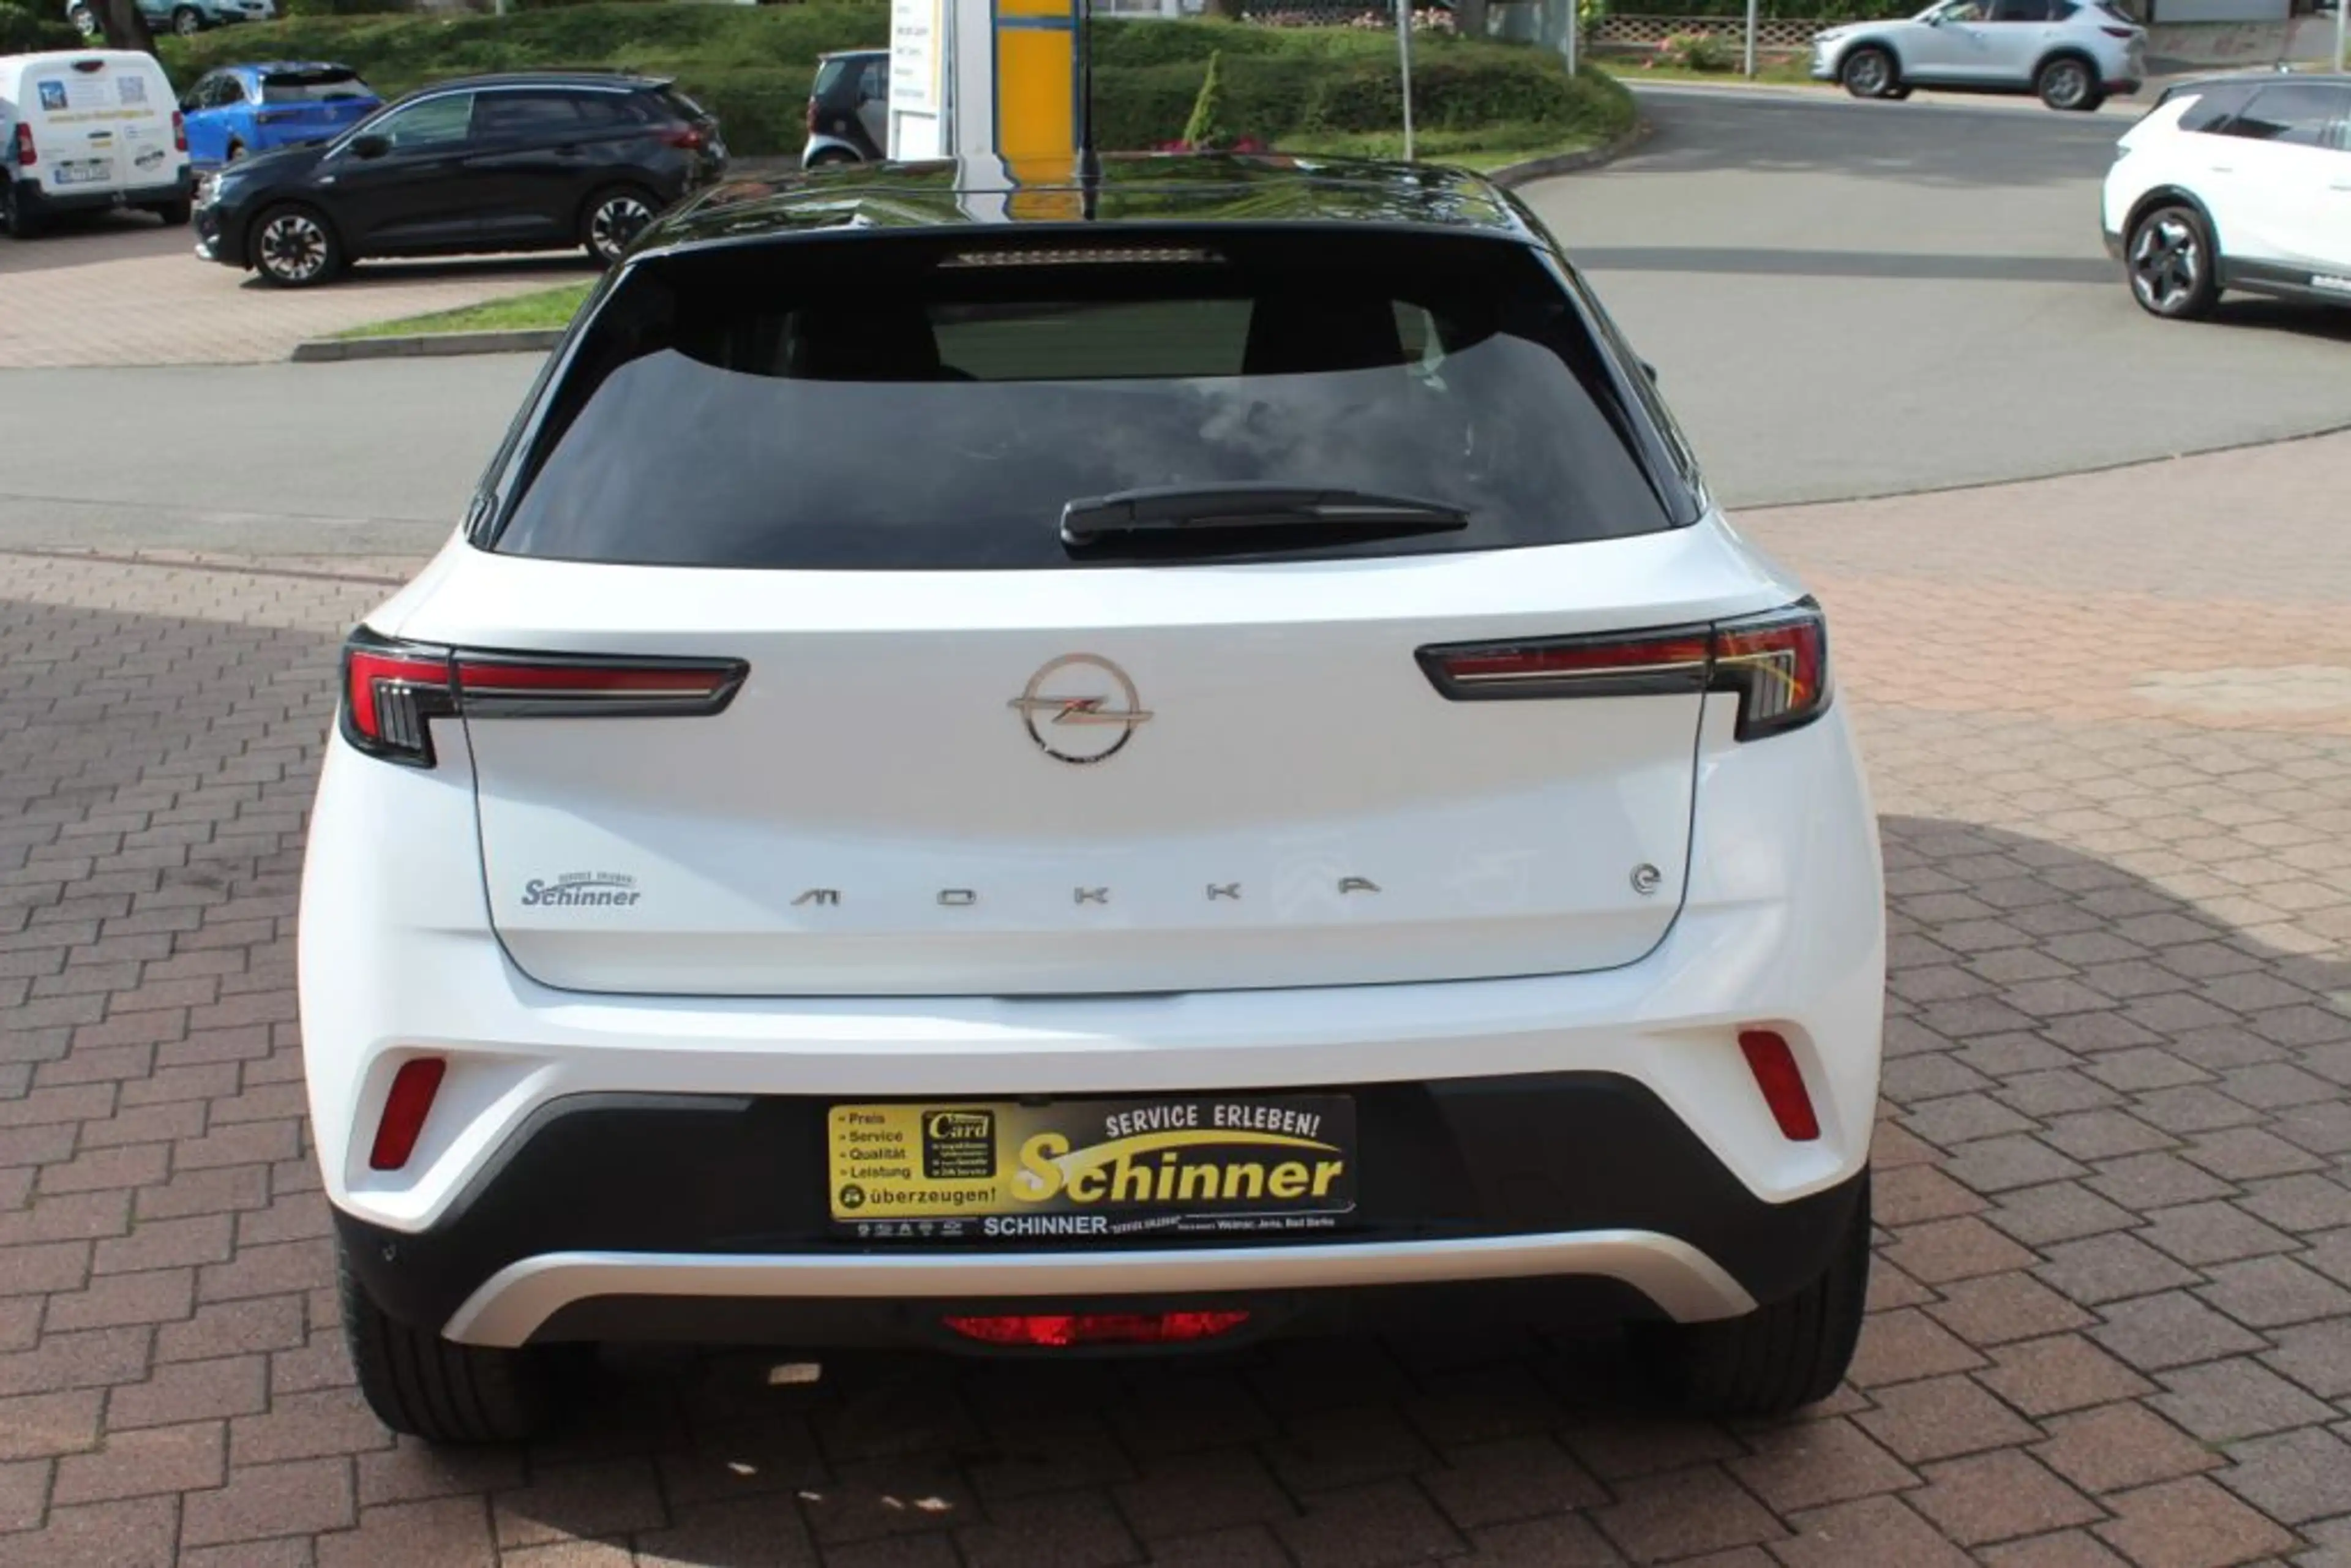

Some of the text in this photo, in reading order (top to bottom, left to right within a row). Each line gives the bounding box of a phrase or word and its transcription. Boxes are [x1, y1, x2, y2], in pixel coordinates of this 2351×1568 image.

[521, 879, 641, 906] Schinner
[791, 877, 1382, 907] MOKKA
[849, 1112, 885, 1124] Preis
[929, 1112, 989, 1140] Card
[1106, 1105, 1321, 1138] SERVICE ERLEBEN!
[849, 1131, 903, 1142] Service
[849, 1148, 906, 1161] Qualität
[850, 1165, 911, 1179] Leistung
[1009, 1132, 1344, 1202] Schinner
[869, 1186, 996, 1206] überzeugen!
[983, 1215, 1108, 1237] SCHINNER
